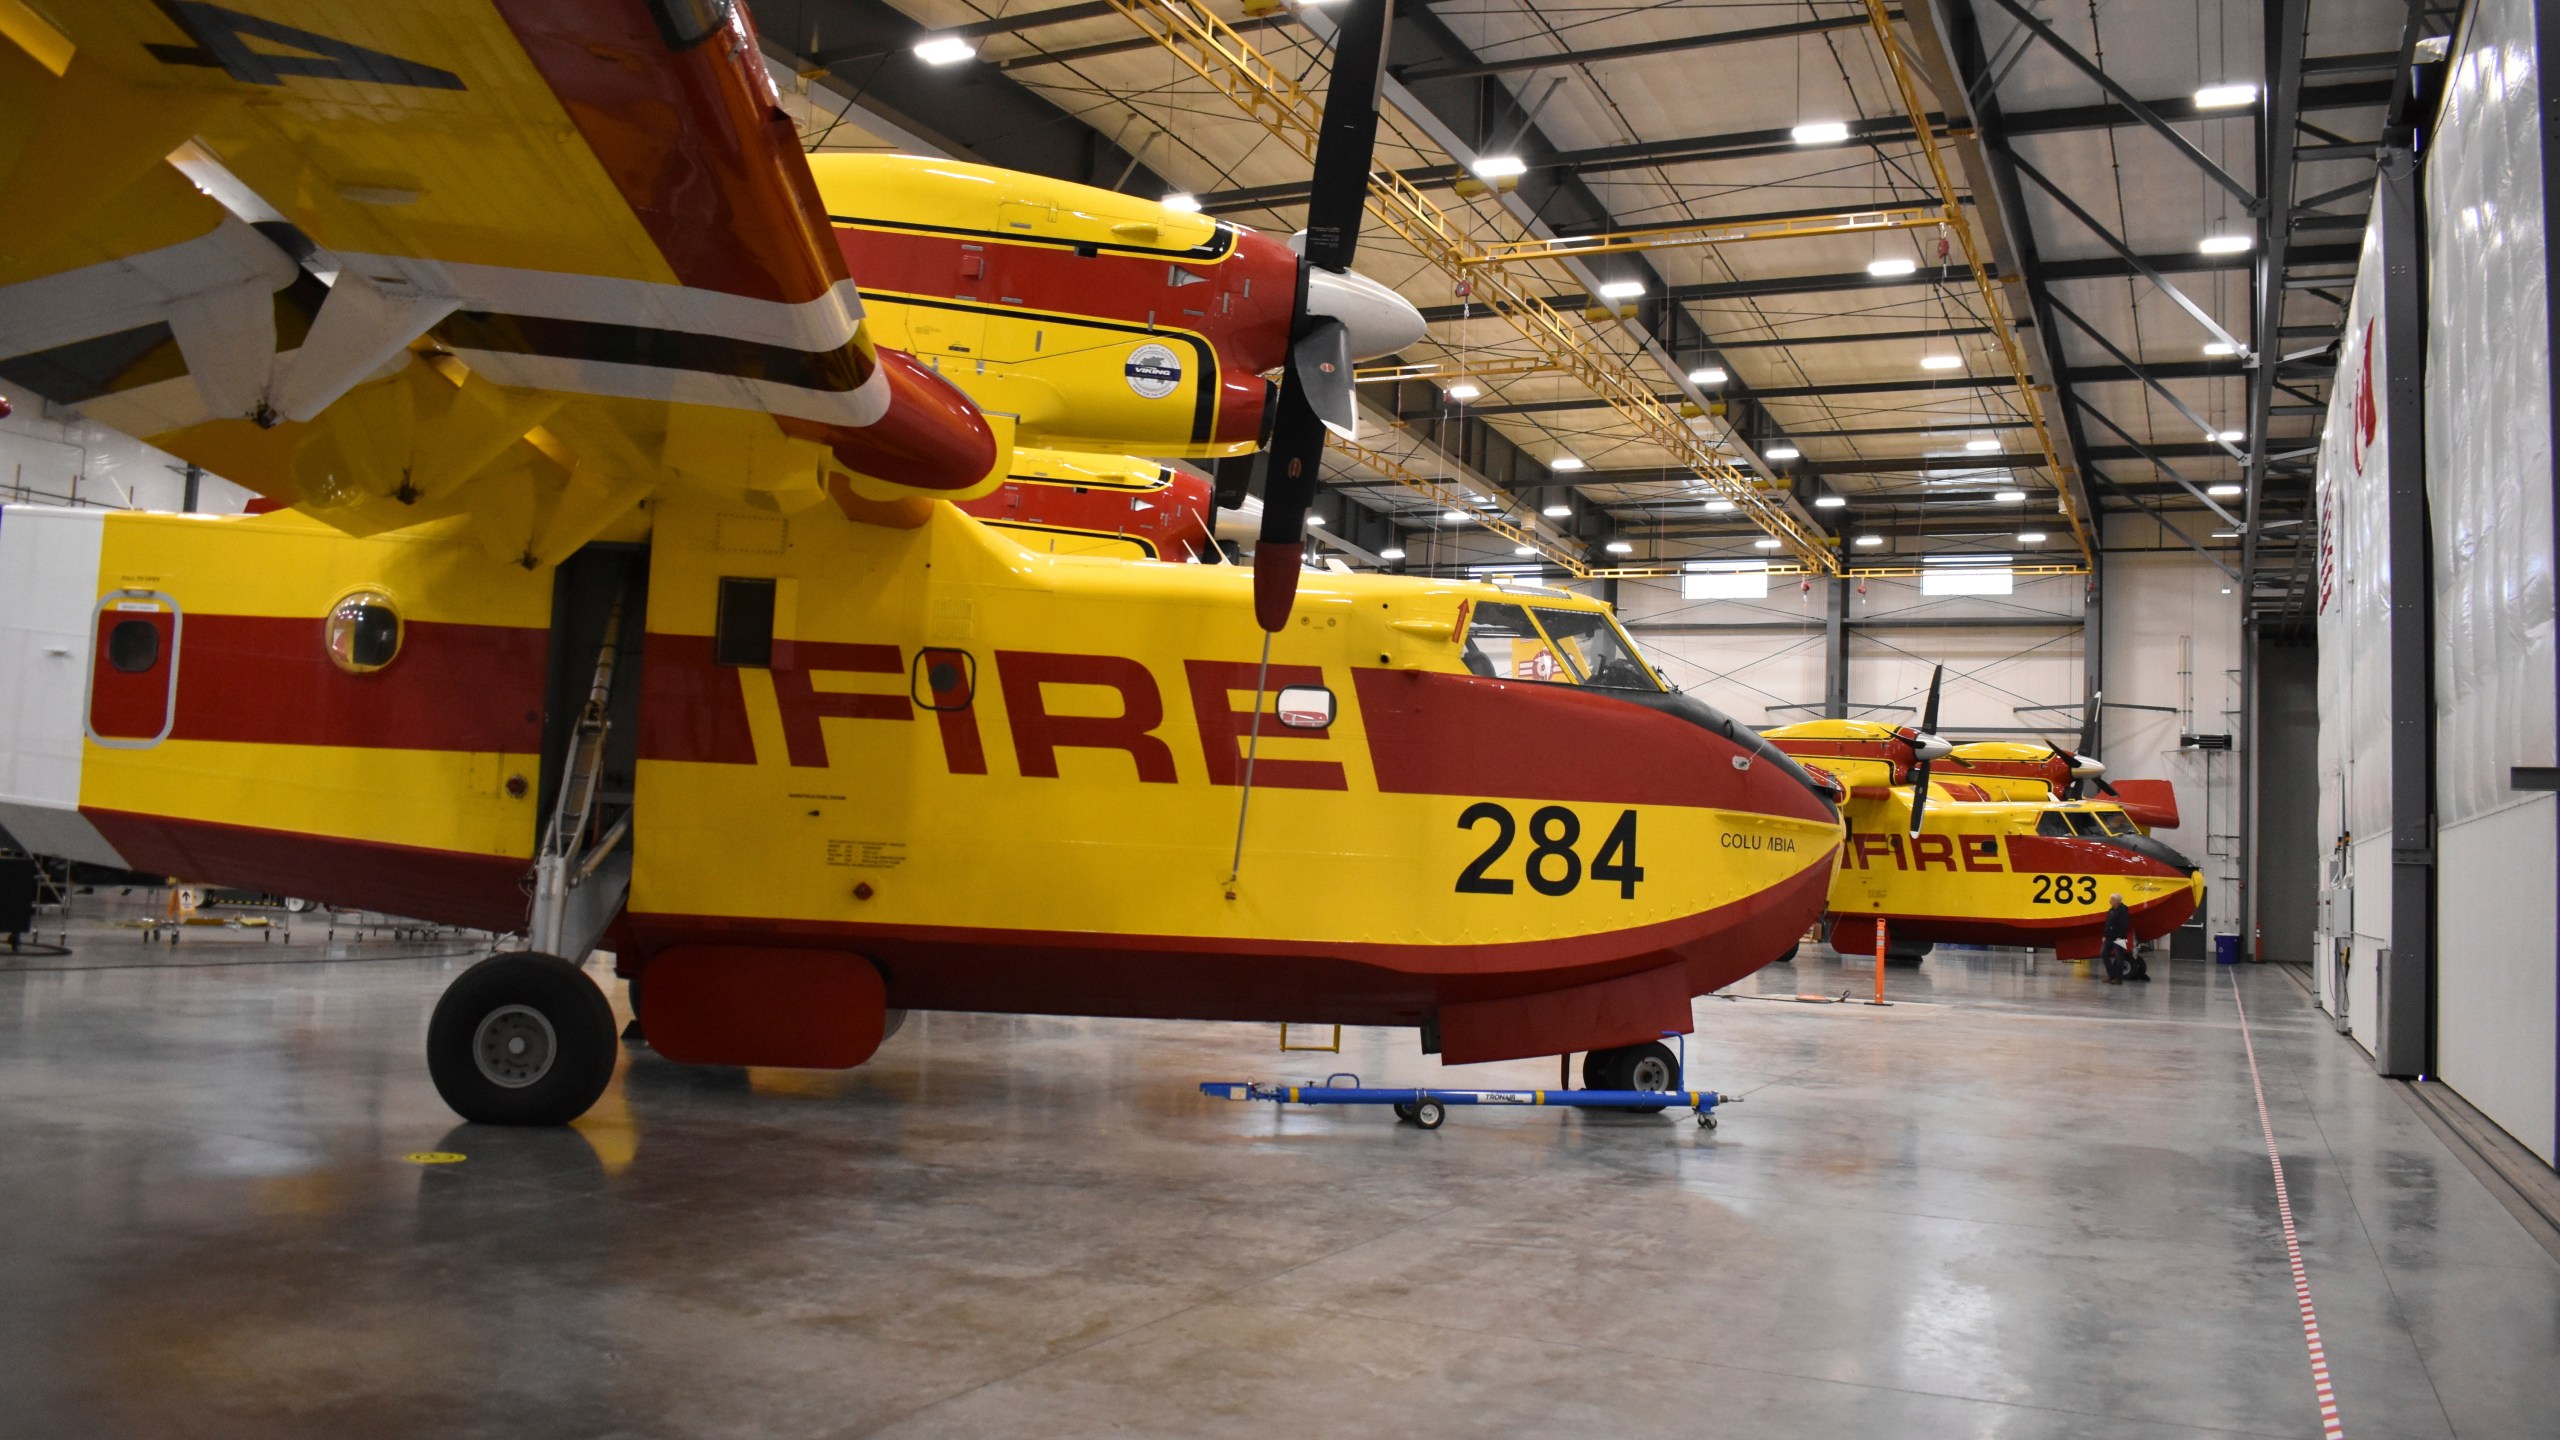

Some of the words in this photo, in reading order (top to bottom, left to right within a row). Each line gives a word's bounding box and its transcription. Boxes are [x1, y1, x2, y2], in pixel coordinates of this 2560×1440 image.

[141, 0, 468, 91] 4
[1135, 367, 1171, 375] VIKING
[770, 639, 1348, 791] FIRE
[1454, 802, 1644, 900] 284
[1852, 833, 2004, 873] FIRE
[2032, 875, 2097, 905] 283
